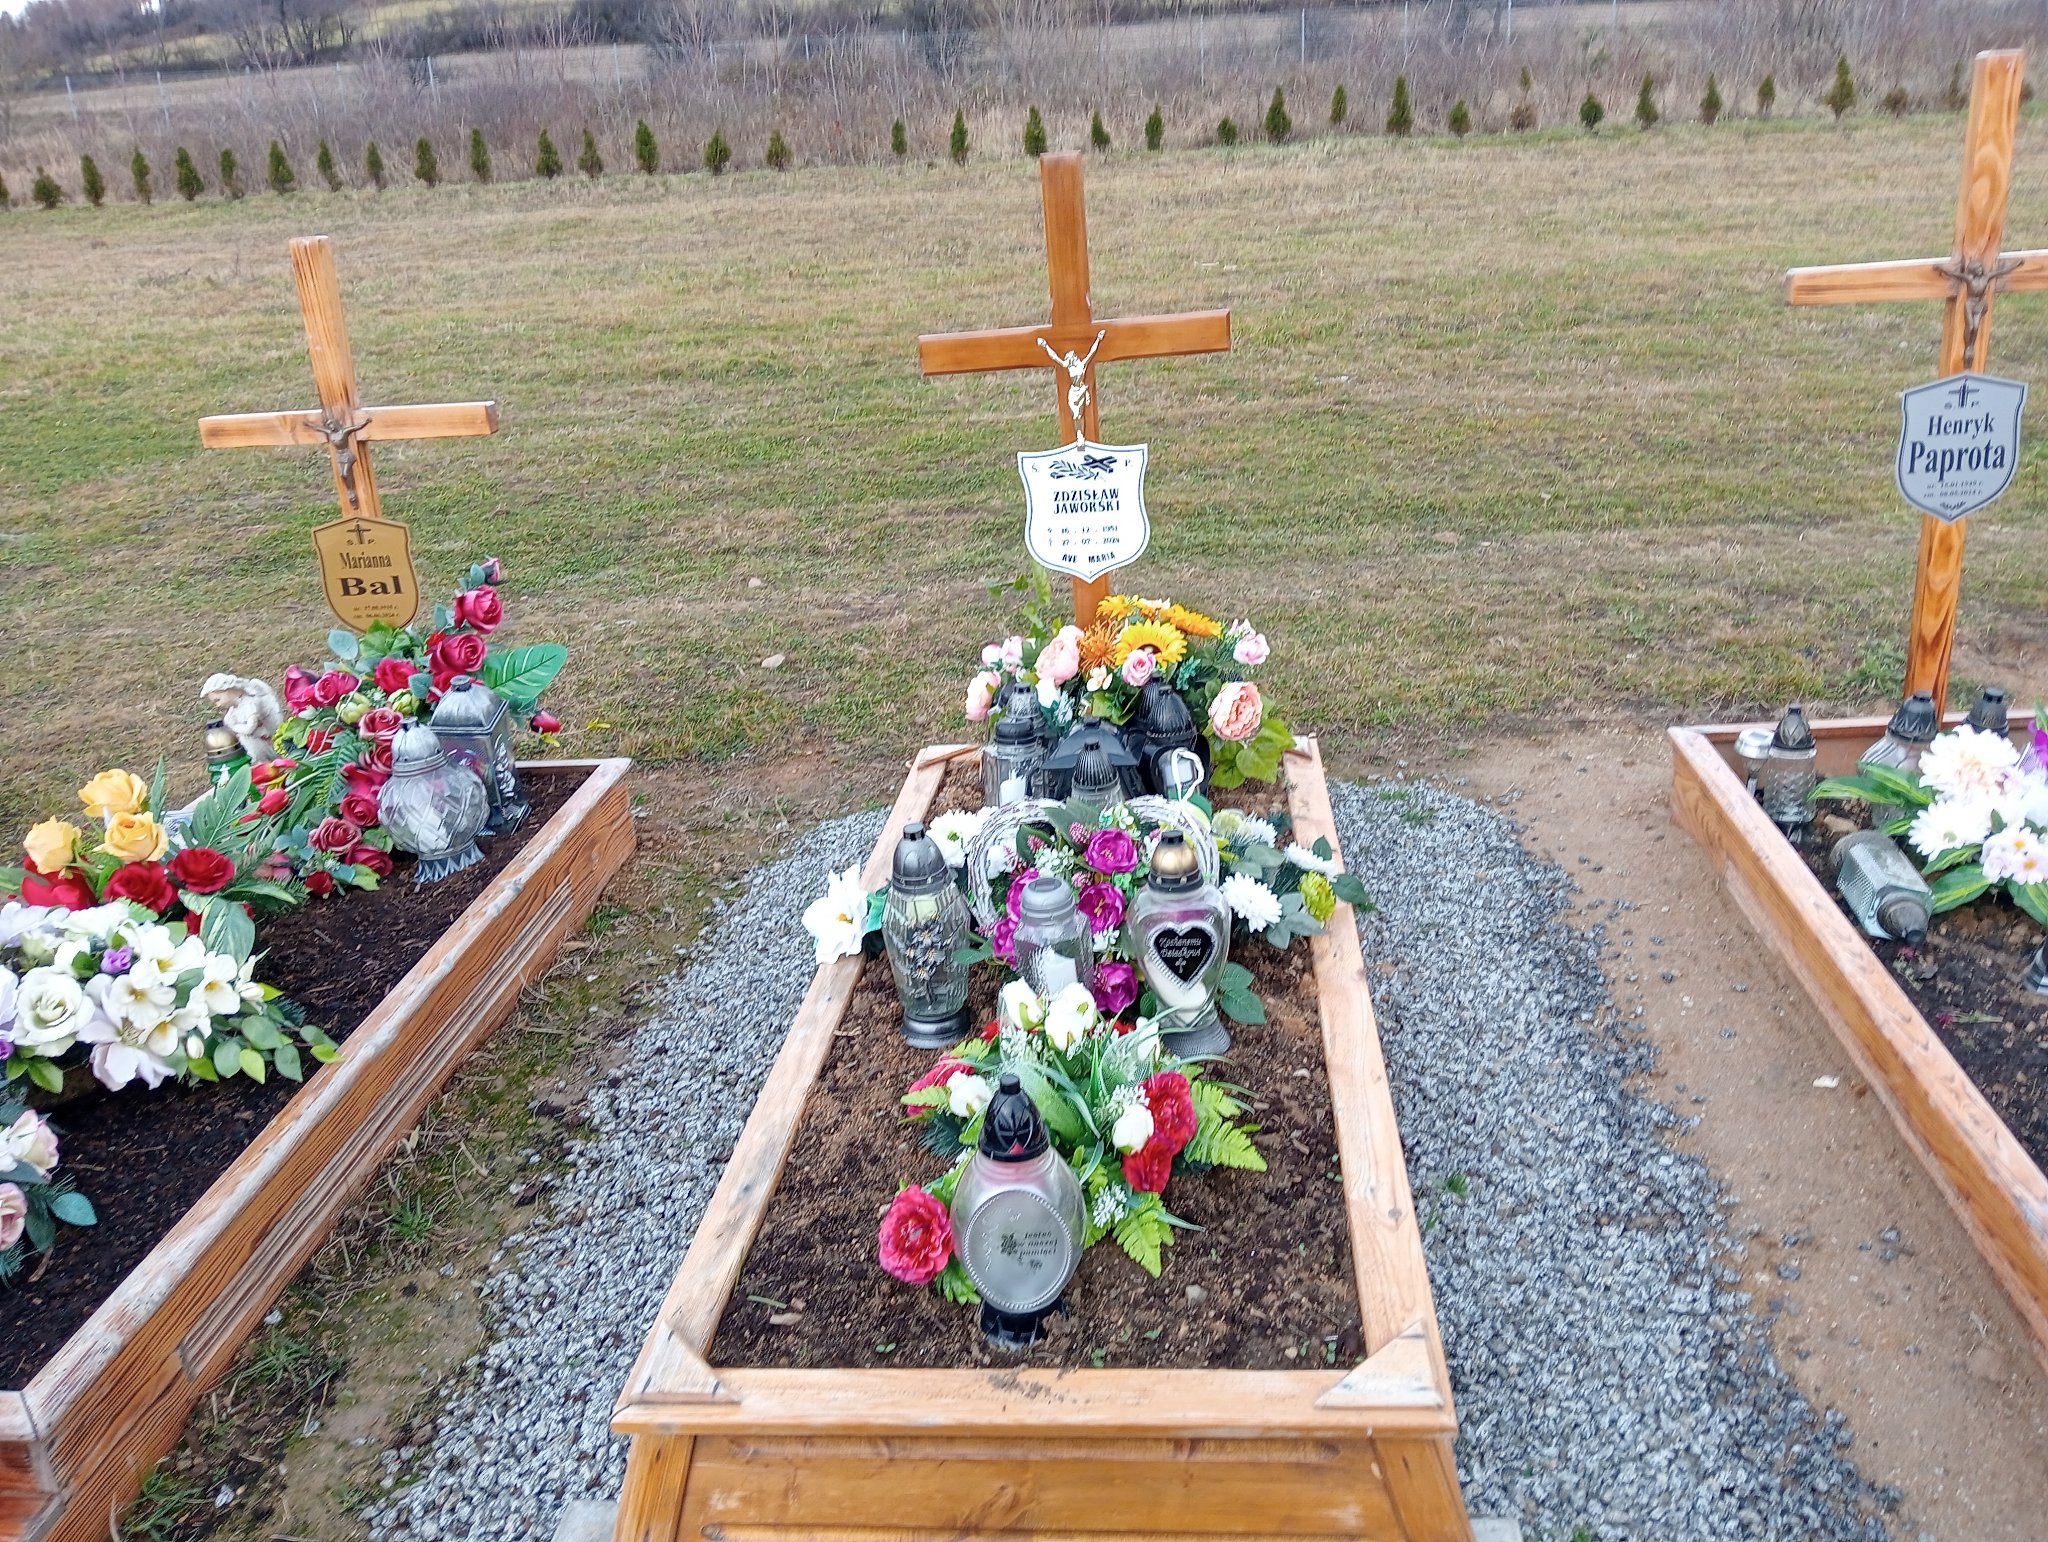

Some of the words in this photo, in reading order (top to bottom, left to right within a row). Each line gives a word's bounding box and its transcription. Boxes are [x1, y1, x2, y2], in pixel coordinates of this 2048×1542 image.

[1927, 412, 1995, 439] Henryk
[1908, 439, 2006, 482] Paprota
[1054, 488, 1120, 502] ZDZISŁAW
[1053, 500, 1120, 515] JAWORSKI
[339, 552, 392, 569] Marianna
[1062, 553, 1077, 563] AVE
[1088, 551, 1116, 563] MARIA
[338, 575, 404, 596] Bal
